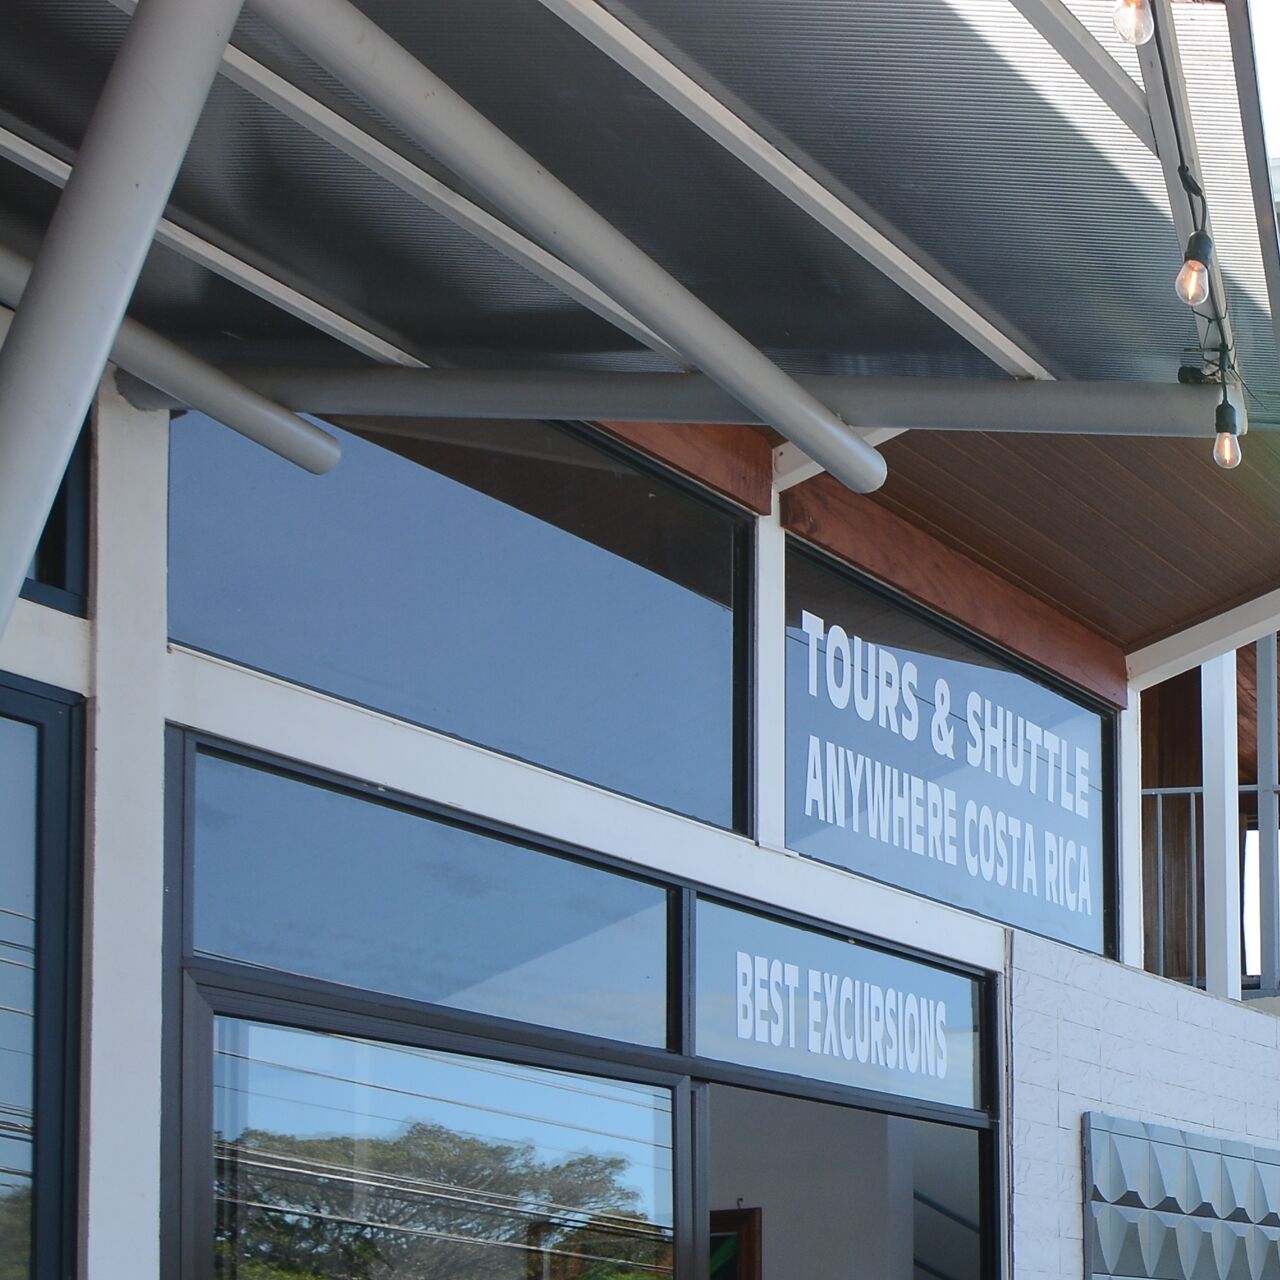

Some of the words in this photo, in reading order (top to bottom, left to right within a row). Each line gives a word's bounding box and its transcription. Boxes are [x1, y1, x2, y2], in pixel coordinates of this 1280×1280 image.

[802, 609, 919, 741] TOURS
[930, 678, 955, 760] &
[966, 691, 1090, 820] SHUTTLE
[804, 735, 958, 866] ANYWHERE
[964, 800, 1038, 897] COSTA
[1045, 831, 1092, 916] RICA
[735, 951, 799, 1049] BEST
[807, 968, 948, 1080] EXCURSIONS
